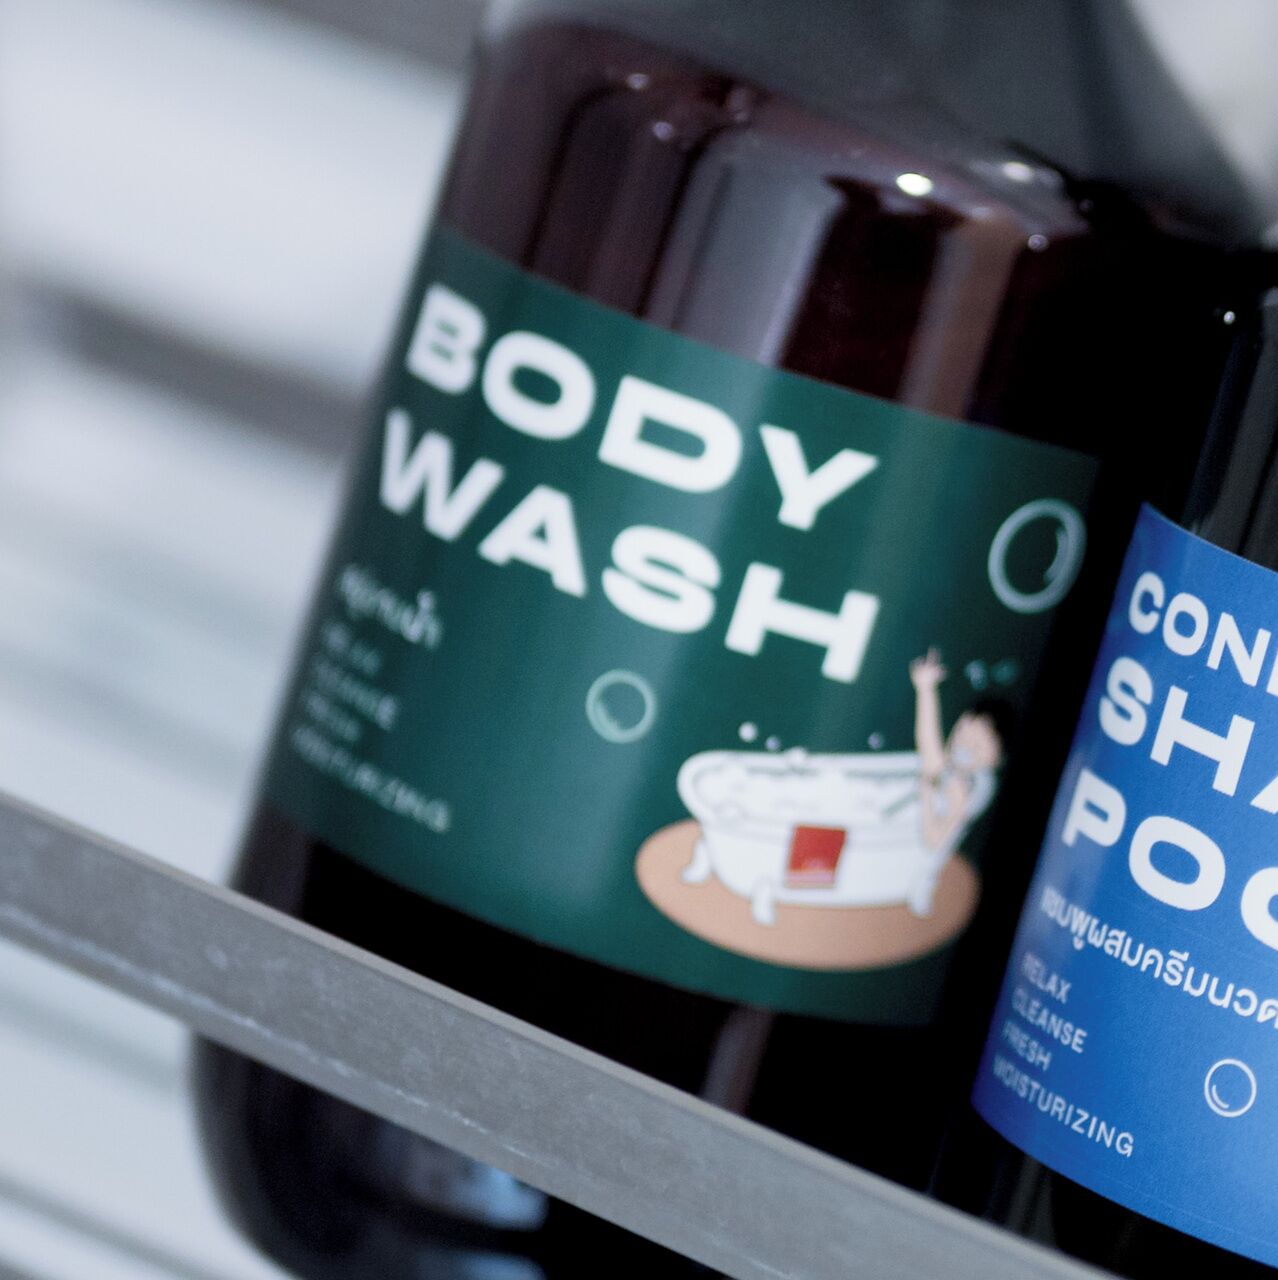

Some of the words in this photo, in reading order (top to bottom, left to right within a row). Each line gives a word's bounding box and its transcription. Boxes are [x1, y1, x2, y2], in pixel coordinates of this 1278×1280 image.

[406, 284, 879, 532] BODY
[379, 410, 879, 685] WASH
[1022, 951, 1072, 1004] RELAX
[1003, 1021, 1052, 1072] FRESH
[1012, 987, 1087, 1053] CLEANSE
[993, 1055, 1135, 1158] MOISTURIZING
